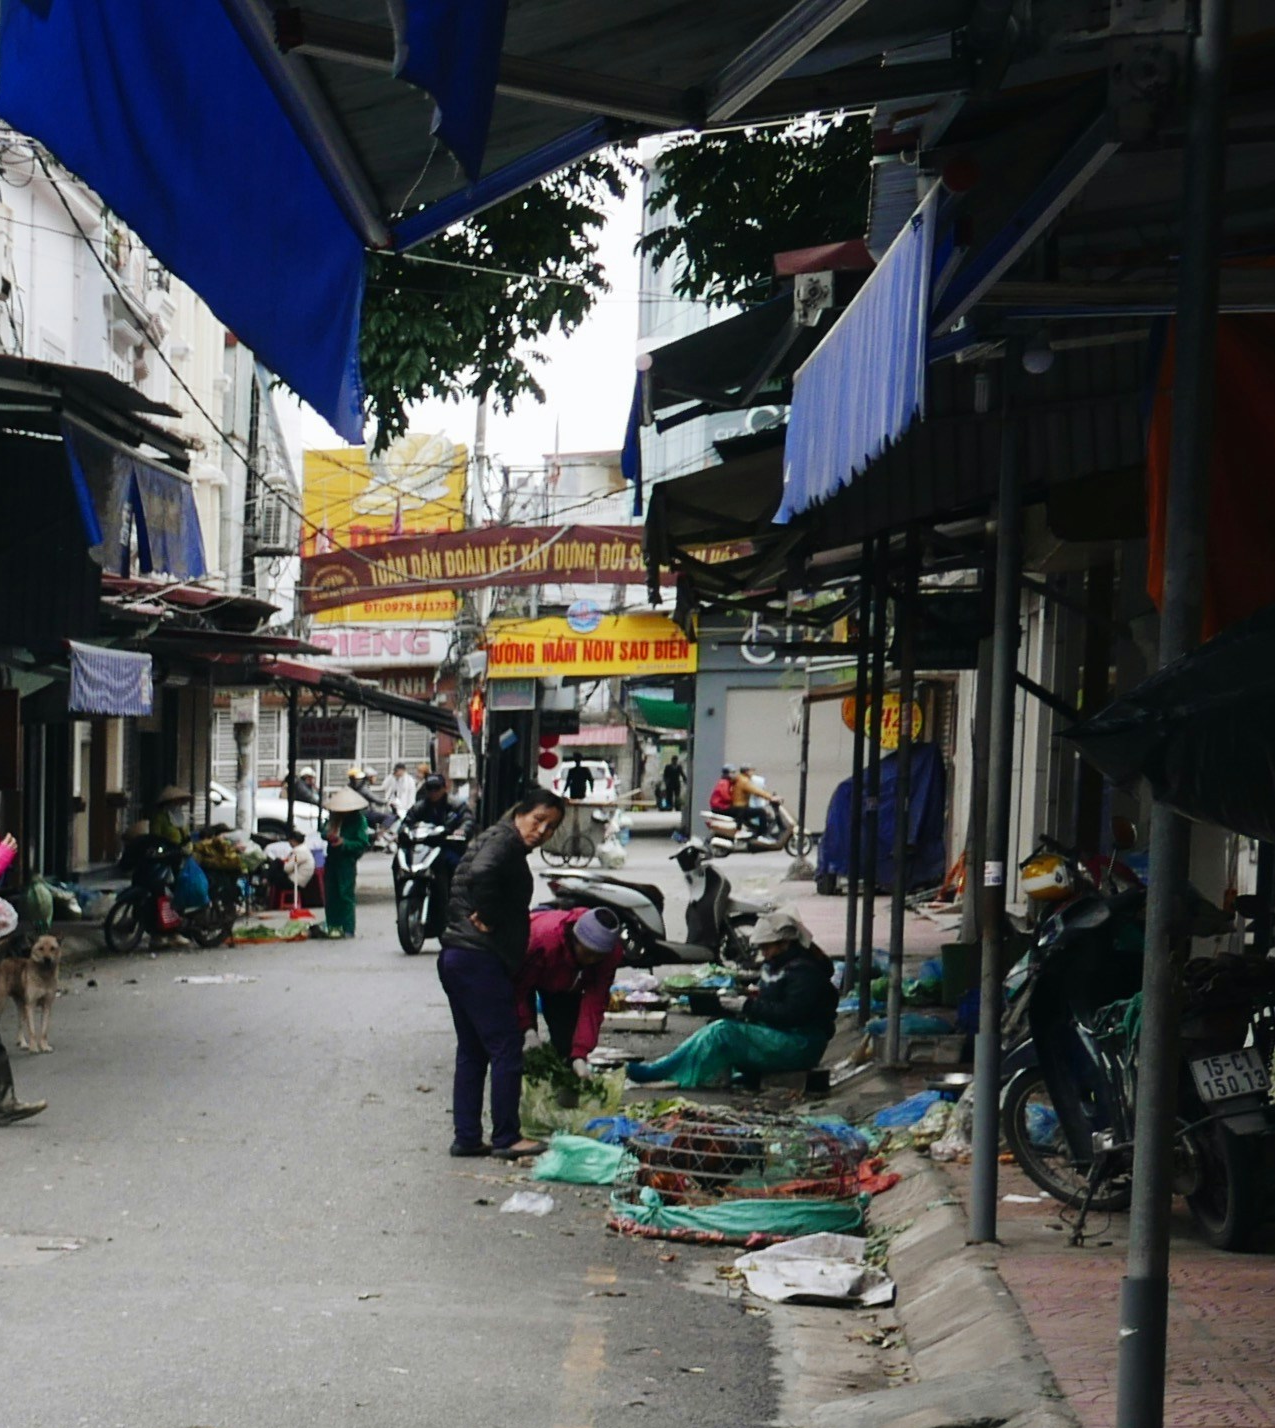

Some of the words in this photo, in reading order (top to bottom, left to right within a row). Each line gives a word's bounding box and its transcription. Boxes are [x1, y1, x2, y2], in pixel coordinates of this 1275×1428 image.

[410, 548, 443, 580] DÂN
[445, 543, 487, 578] ĐOÀN
[489, 538, 517, 574] KẾT
[553, 540, 596, 576] DỰNG
[542, 633, 578, 664] MẦM
[583, 639, 614, 662] NON
[619, 640, 649, 661] SAO
[1202, 1051, 1253, 1078] 15-C1
[1203, 1068, 1268, 1099] 150.13
